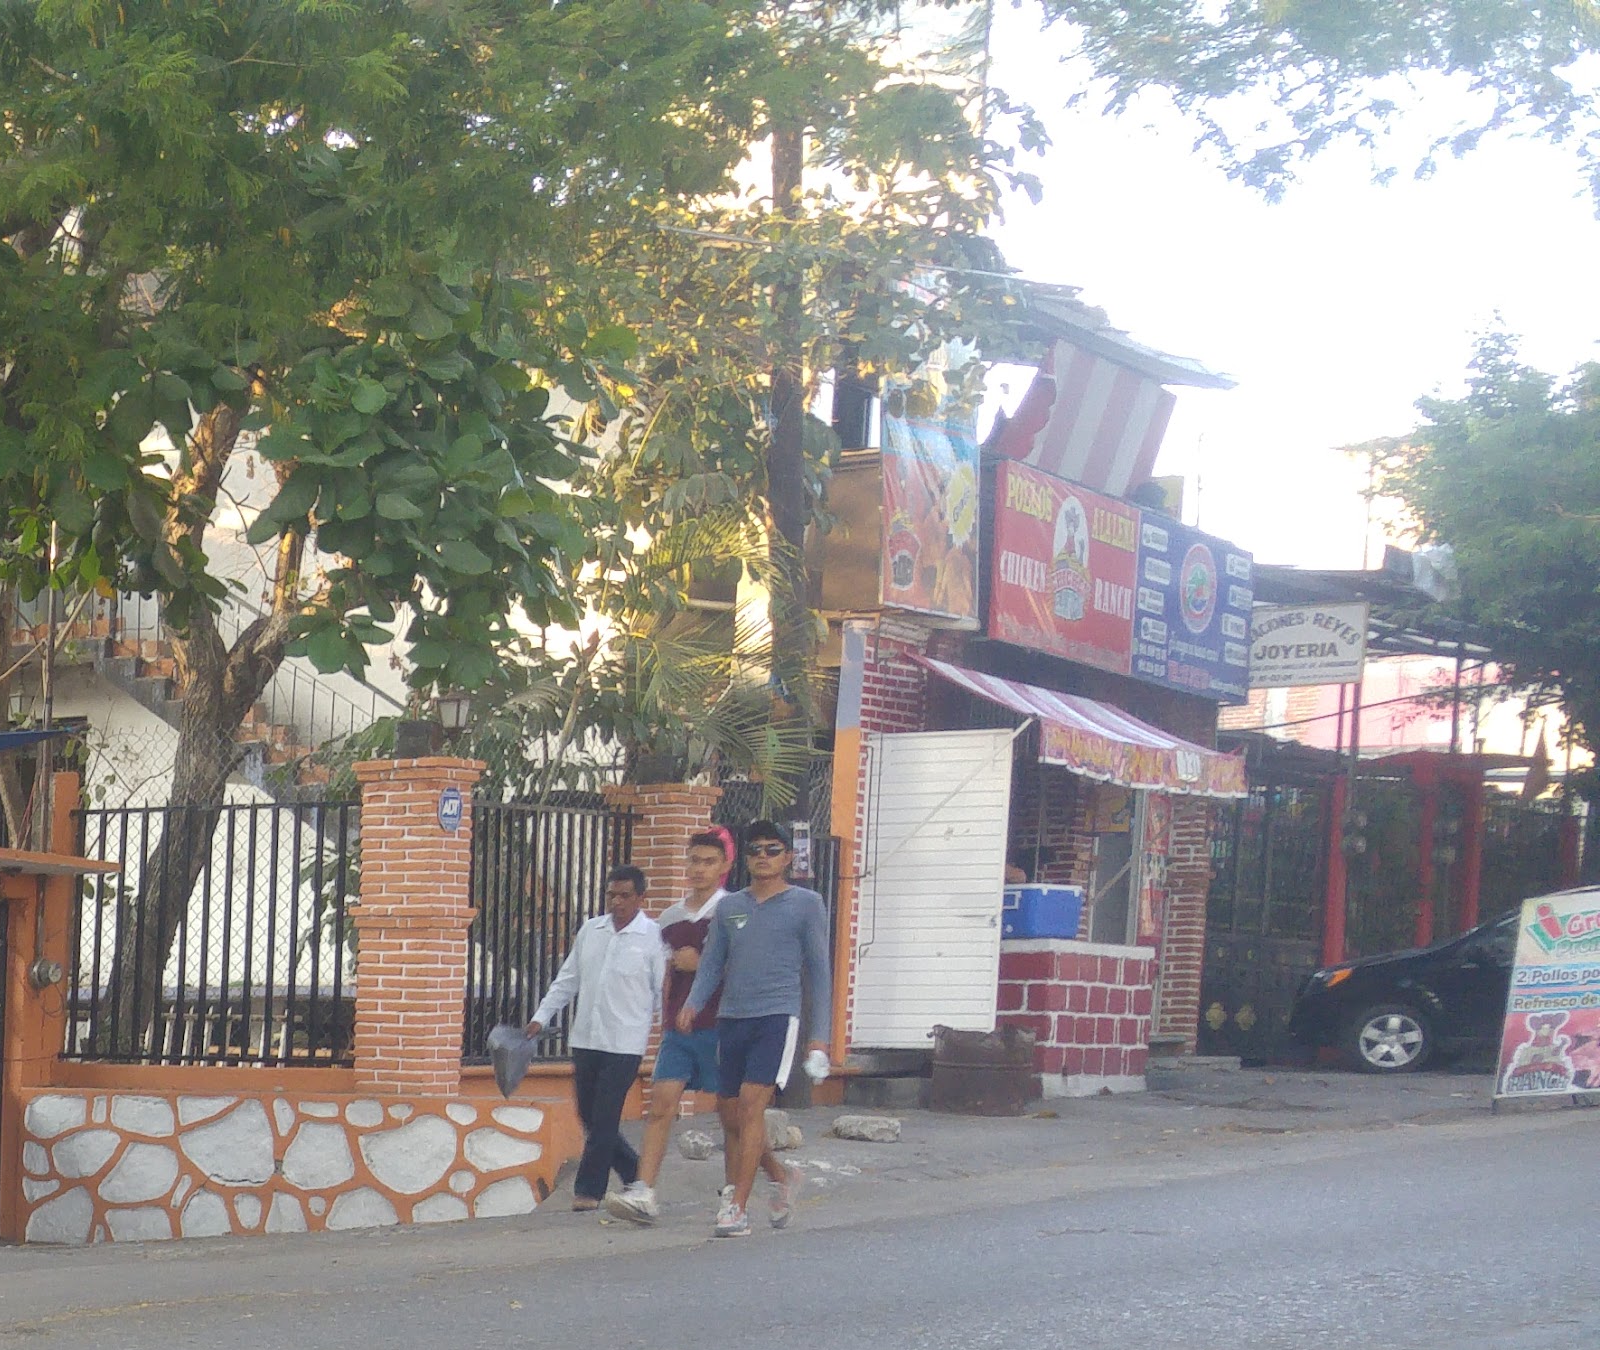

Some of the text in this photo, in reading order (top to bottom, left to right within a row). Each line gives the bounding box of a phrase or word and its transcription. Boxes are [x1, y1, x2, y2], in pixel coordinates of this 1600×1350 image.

[1000, 550, 1047, 592] CHICKEN
[1094, 577, 1132, 620] RANCH
[1313, 612, 1361, 645] REYES
[1254, 642, 1339, 660] JOYERIA
[442, 798, 460, 816] ADT
[1516, 970, 1528, 983] 2
[1531, 968, 1578, 982] Pollos
[1513, 994, 1598, 1010] Refresco de
